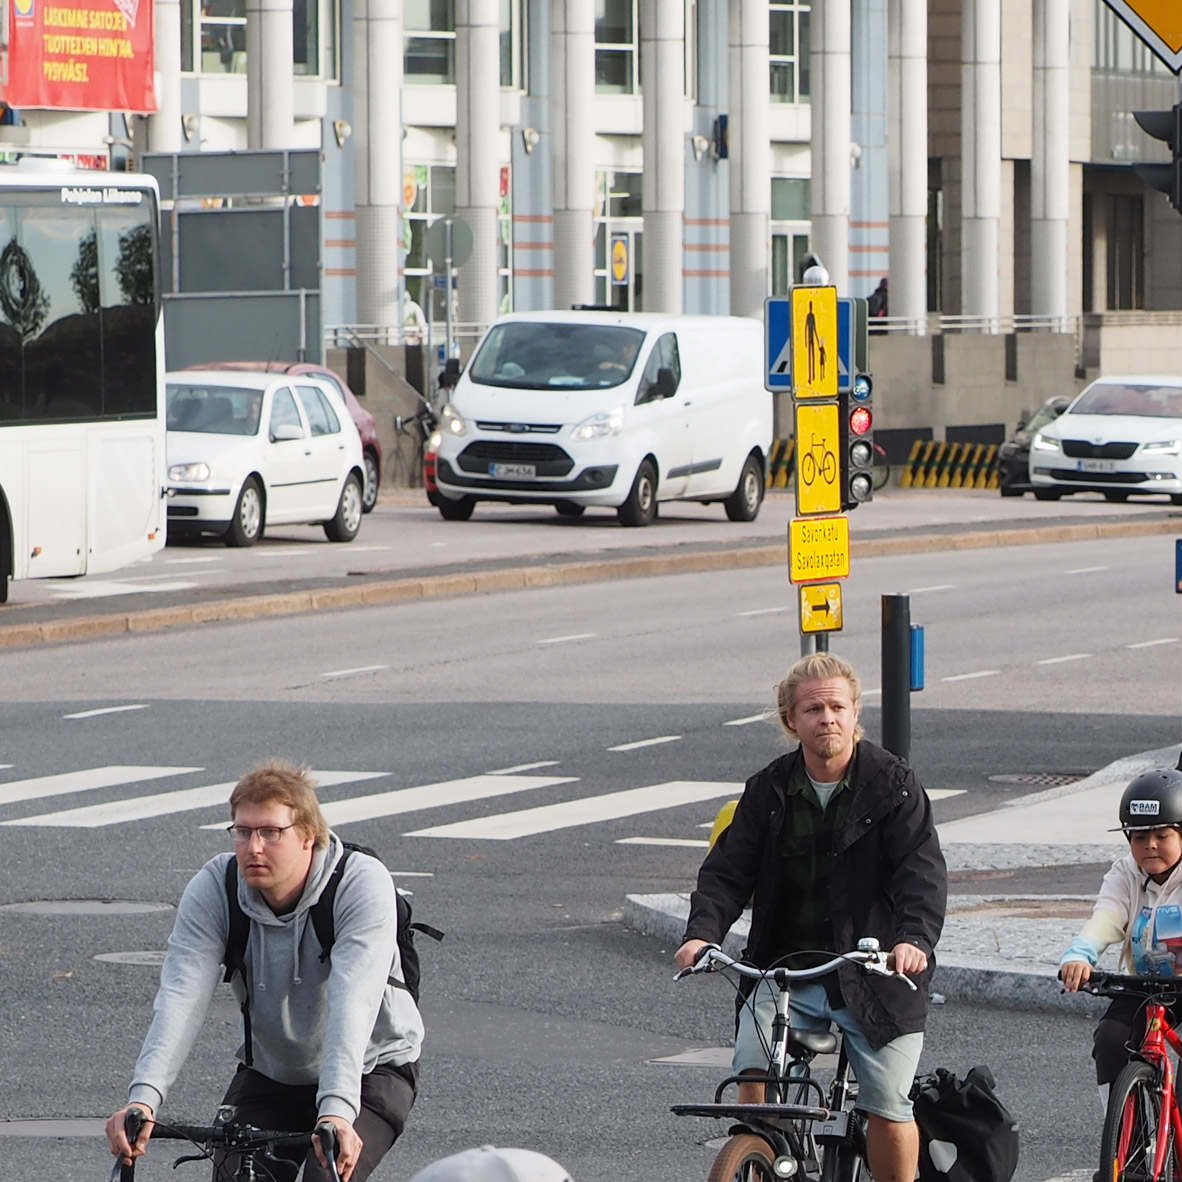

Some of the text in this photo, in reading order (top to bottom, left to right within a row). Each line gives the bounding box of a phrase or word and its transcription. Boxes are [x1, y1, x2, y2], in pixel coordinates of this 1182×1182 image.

[43, 34, 97, 56] TUOTTEIDEN
[801, 523, 839, 543] Savonkatu
[797, 549, 845, 571] Savolaxgatan
[1156, 906, 1178, 914] TIVE
